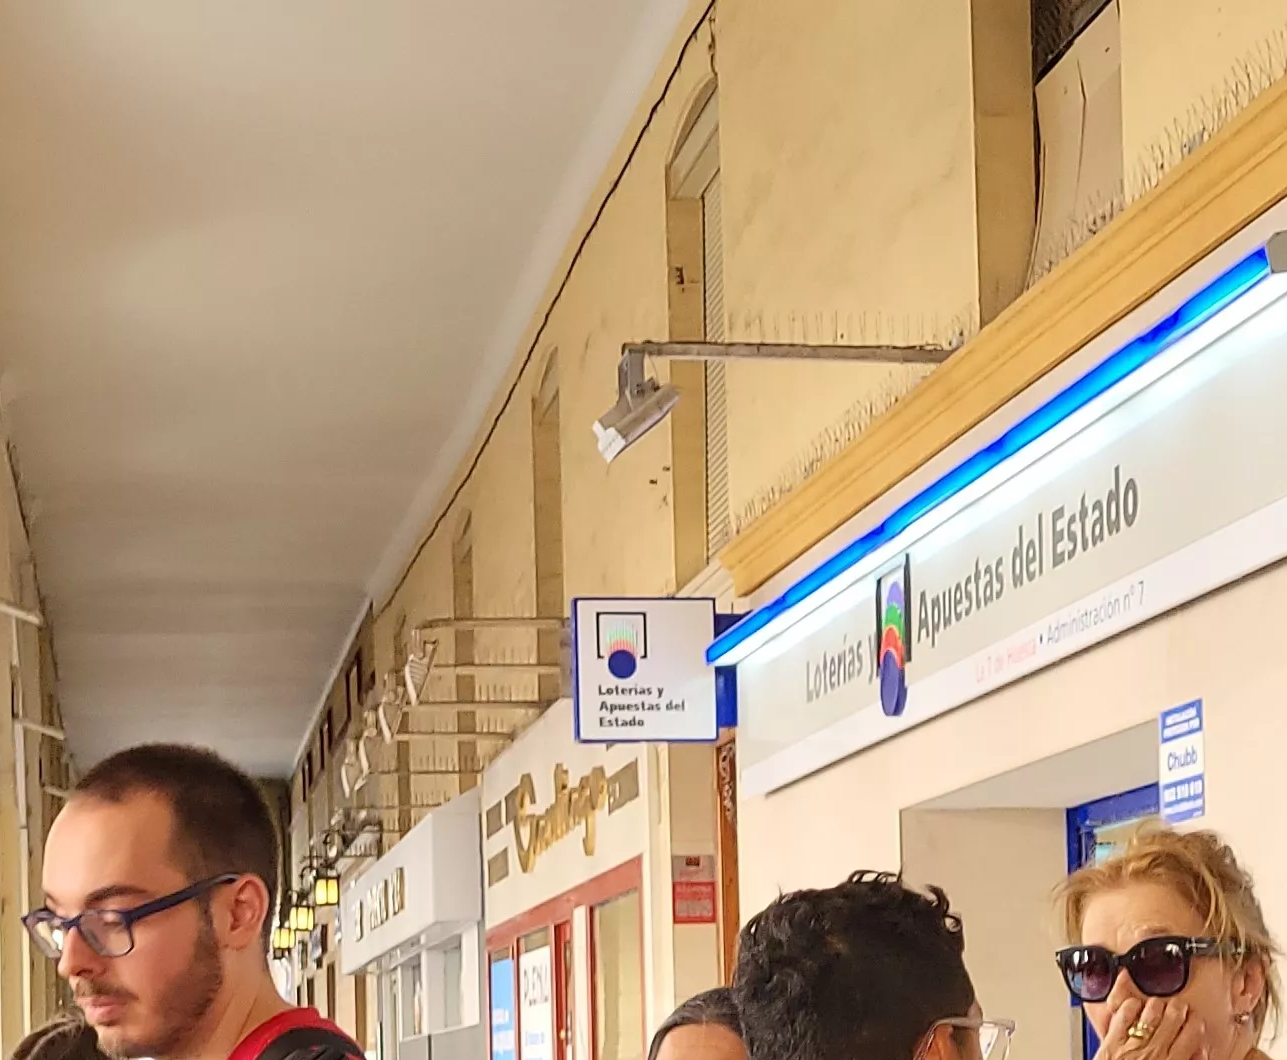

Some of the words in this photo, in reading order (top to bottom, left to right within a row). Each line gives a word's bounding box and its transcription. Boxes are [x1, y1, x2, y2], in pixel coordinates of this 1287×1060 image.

[806, 634, 862, 704] Loterías
[917, 551, 1004, 648] Apuestas
[1011, 513, 1043, 589] del
[1052, 465, 1139, 569] Estado
[1047, 594, 1121, 645] Administración
[1138, 581, 1145, 605] 7
[657, 687, 664, 699] y
[599, 701, 662, 715] Apuestas
[665, 699, 686, 712] del
[599, 716, 645, 728] Estado
[1167, 745, 1198, 772] Chubb
